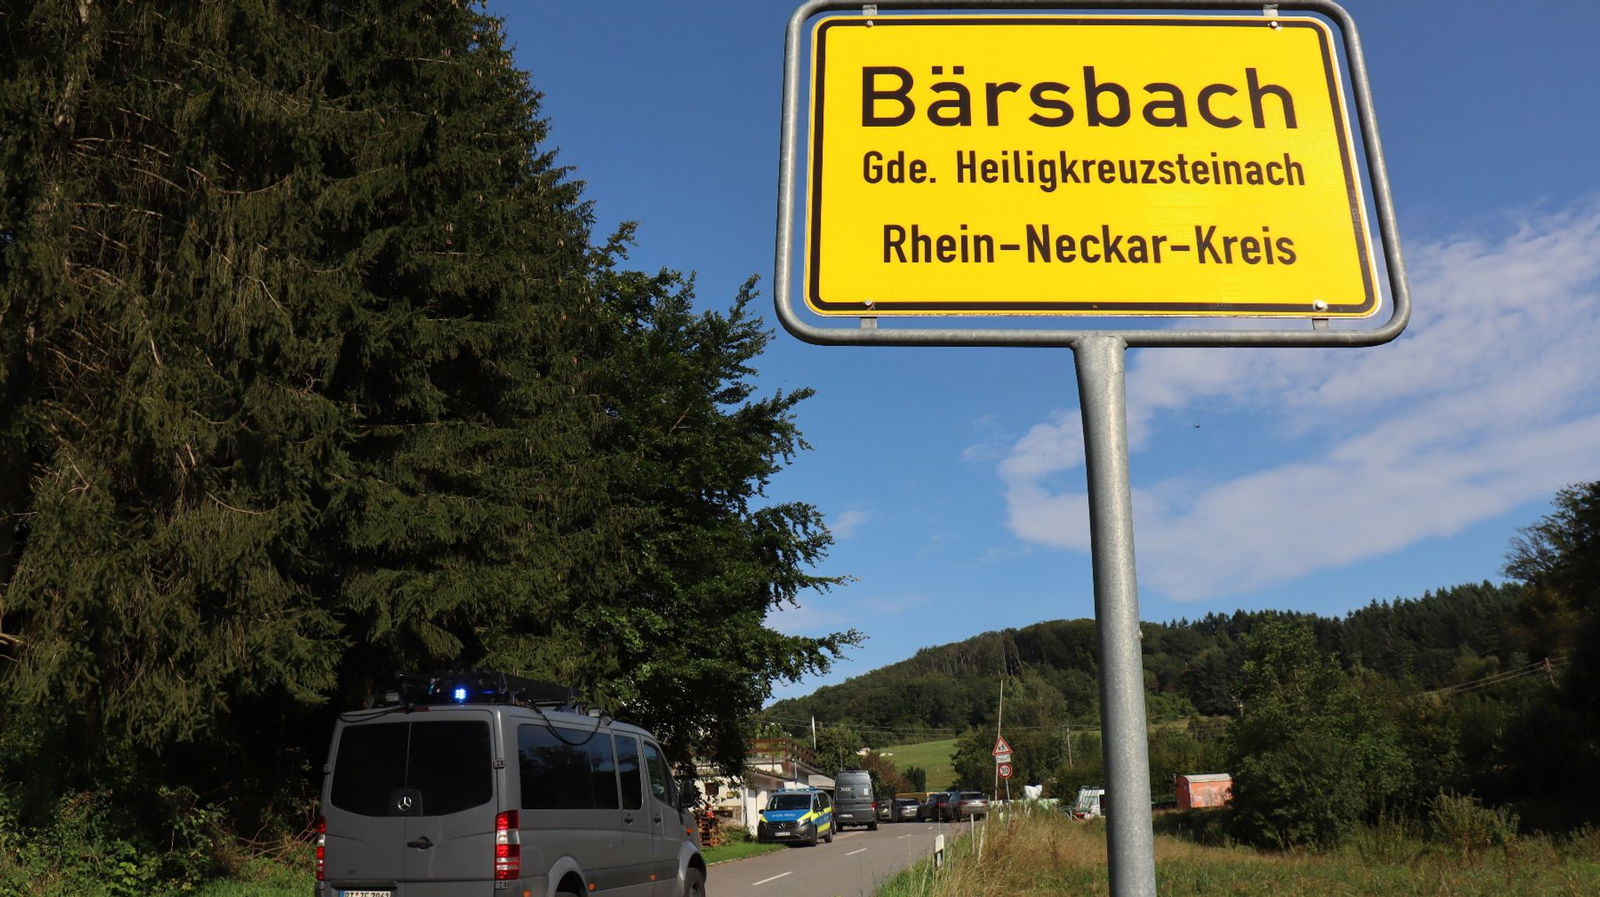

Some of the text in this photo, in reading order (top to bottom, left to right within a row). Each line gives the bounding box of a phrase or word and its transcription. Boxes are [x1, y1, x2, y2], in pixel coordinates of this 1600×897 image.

[862, 65, 1298, 129] Bärsbach
[863, 150, 1305, 193] Gde. Heiligkreuzsteinach
[883, 224, 1296, 265] Rhein-Neckar-Kreis
